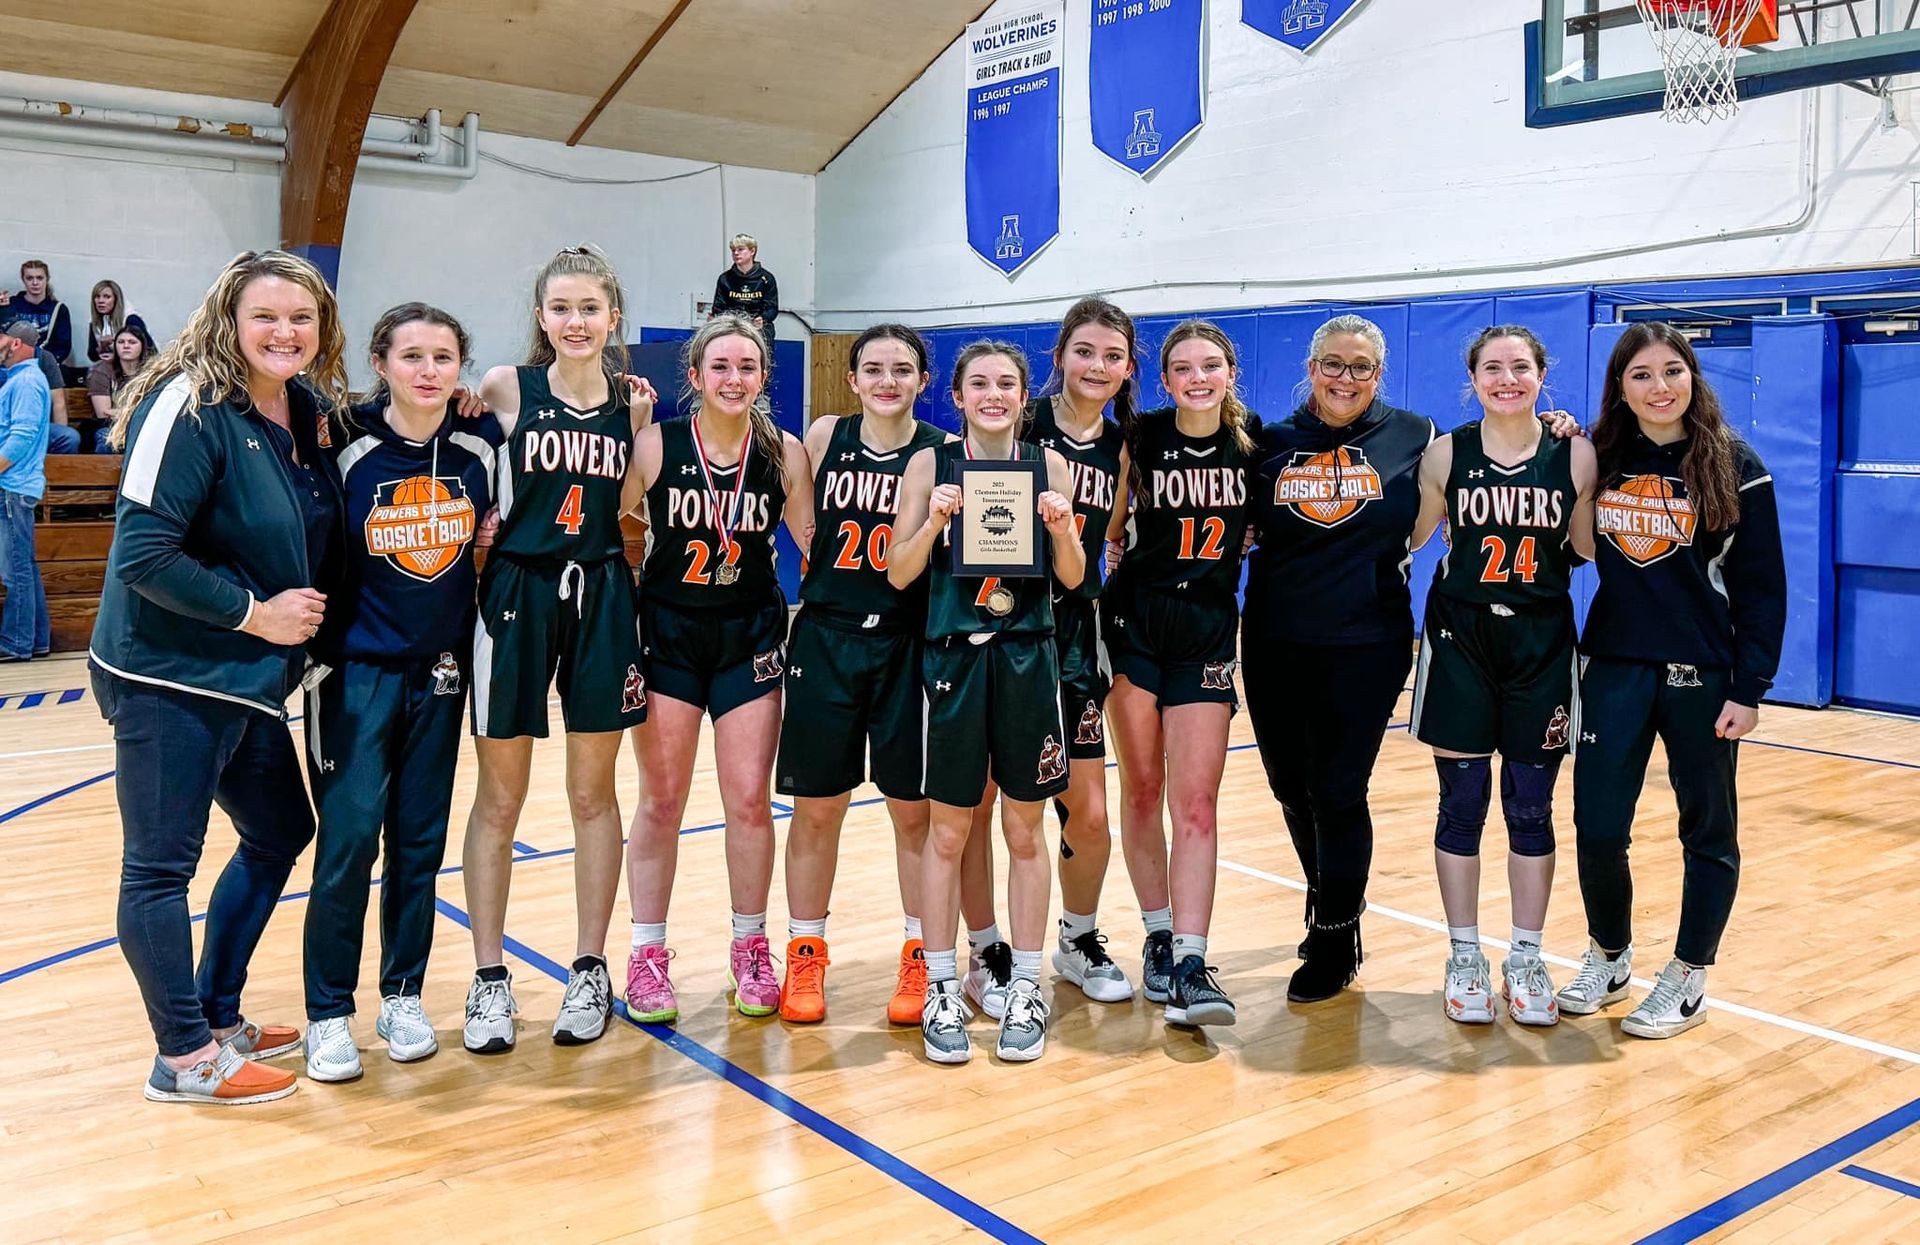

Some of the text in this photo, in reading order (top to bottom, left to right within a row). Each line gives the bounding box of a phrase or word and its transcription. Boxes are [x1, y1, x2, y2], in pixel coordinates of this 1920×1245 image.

[985, 12, 1043, 35] ALSEA HIGH SCHOOL
[1098, 0, 1171, 26] 1997 1998 2000
[973, 19, 1057, 54] WOLVERINES
[976, 65, 996, 80] GIRLS
[999, 59, 1022, 76] TRACK
[1033, 50, 1051, 68] FIELD
[978, 77, 1048, 103] LEAGUE CHAMPS
[973, 102, 1011, 121] 1996 1997
[524, 430, 627, 480] POWERS
[1286, 465, 1322, 475] POWERS
[822, 470, 903, 514] POWE
[1069, 460, 1114, 511] WERS
[1152, 467, 1246, 508] POWERS
[1280, 478, 1376, 499] BASKETBALL
[1601, 491, 1638, 505] POWERS
[373, 500, 469, 520] POWERS CUISERS
[555, 484, 585, 535] 4
[668, 487, 769, 532] POWERS
[1457, 486, 1563, 529] POWERS
[1598, 506, 1689, 540] BASKETBALL
[371, 517, 471, 550] BASKETBALL
[833, 520, 894, 571] 20
[1177, 516, 1225, 560] 12
[1480, 535, 1538, 583] 24
